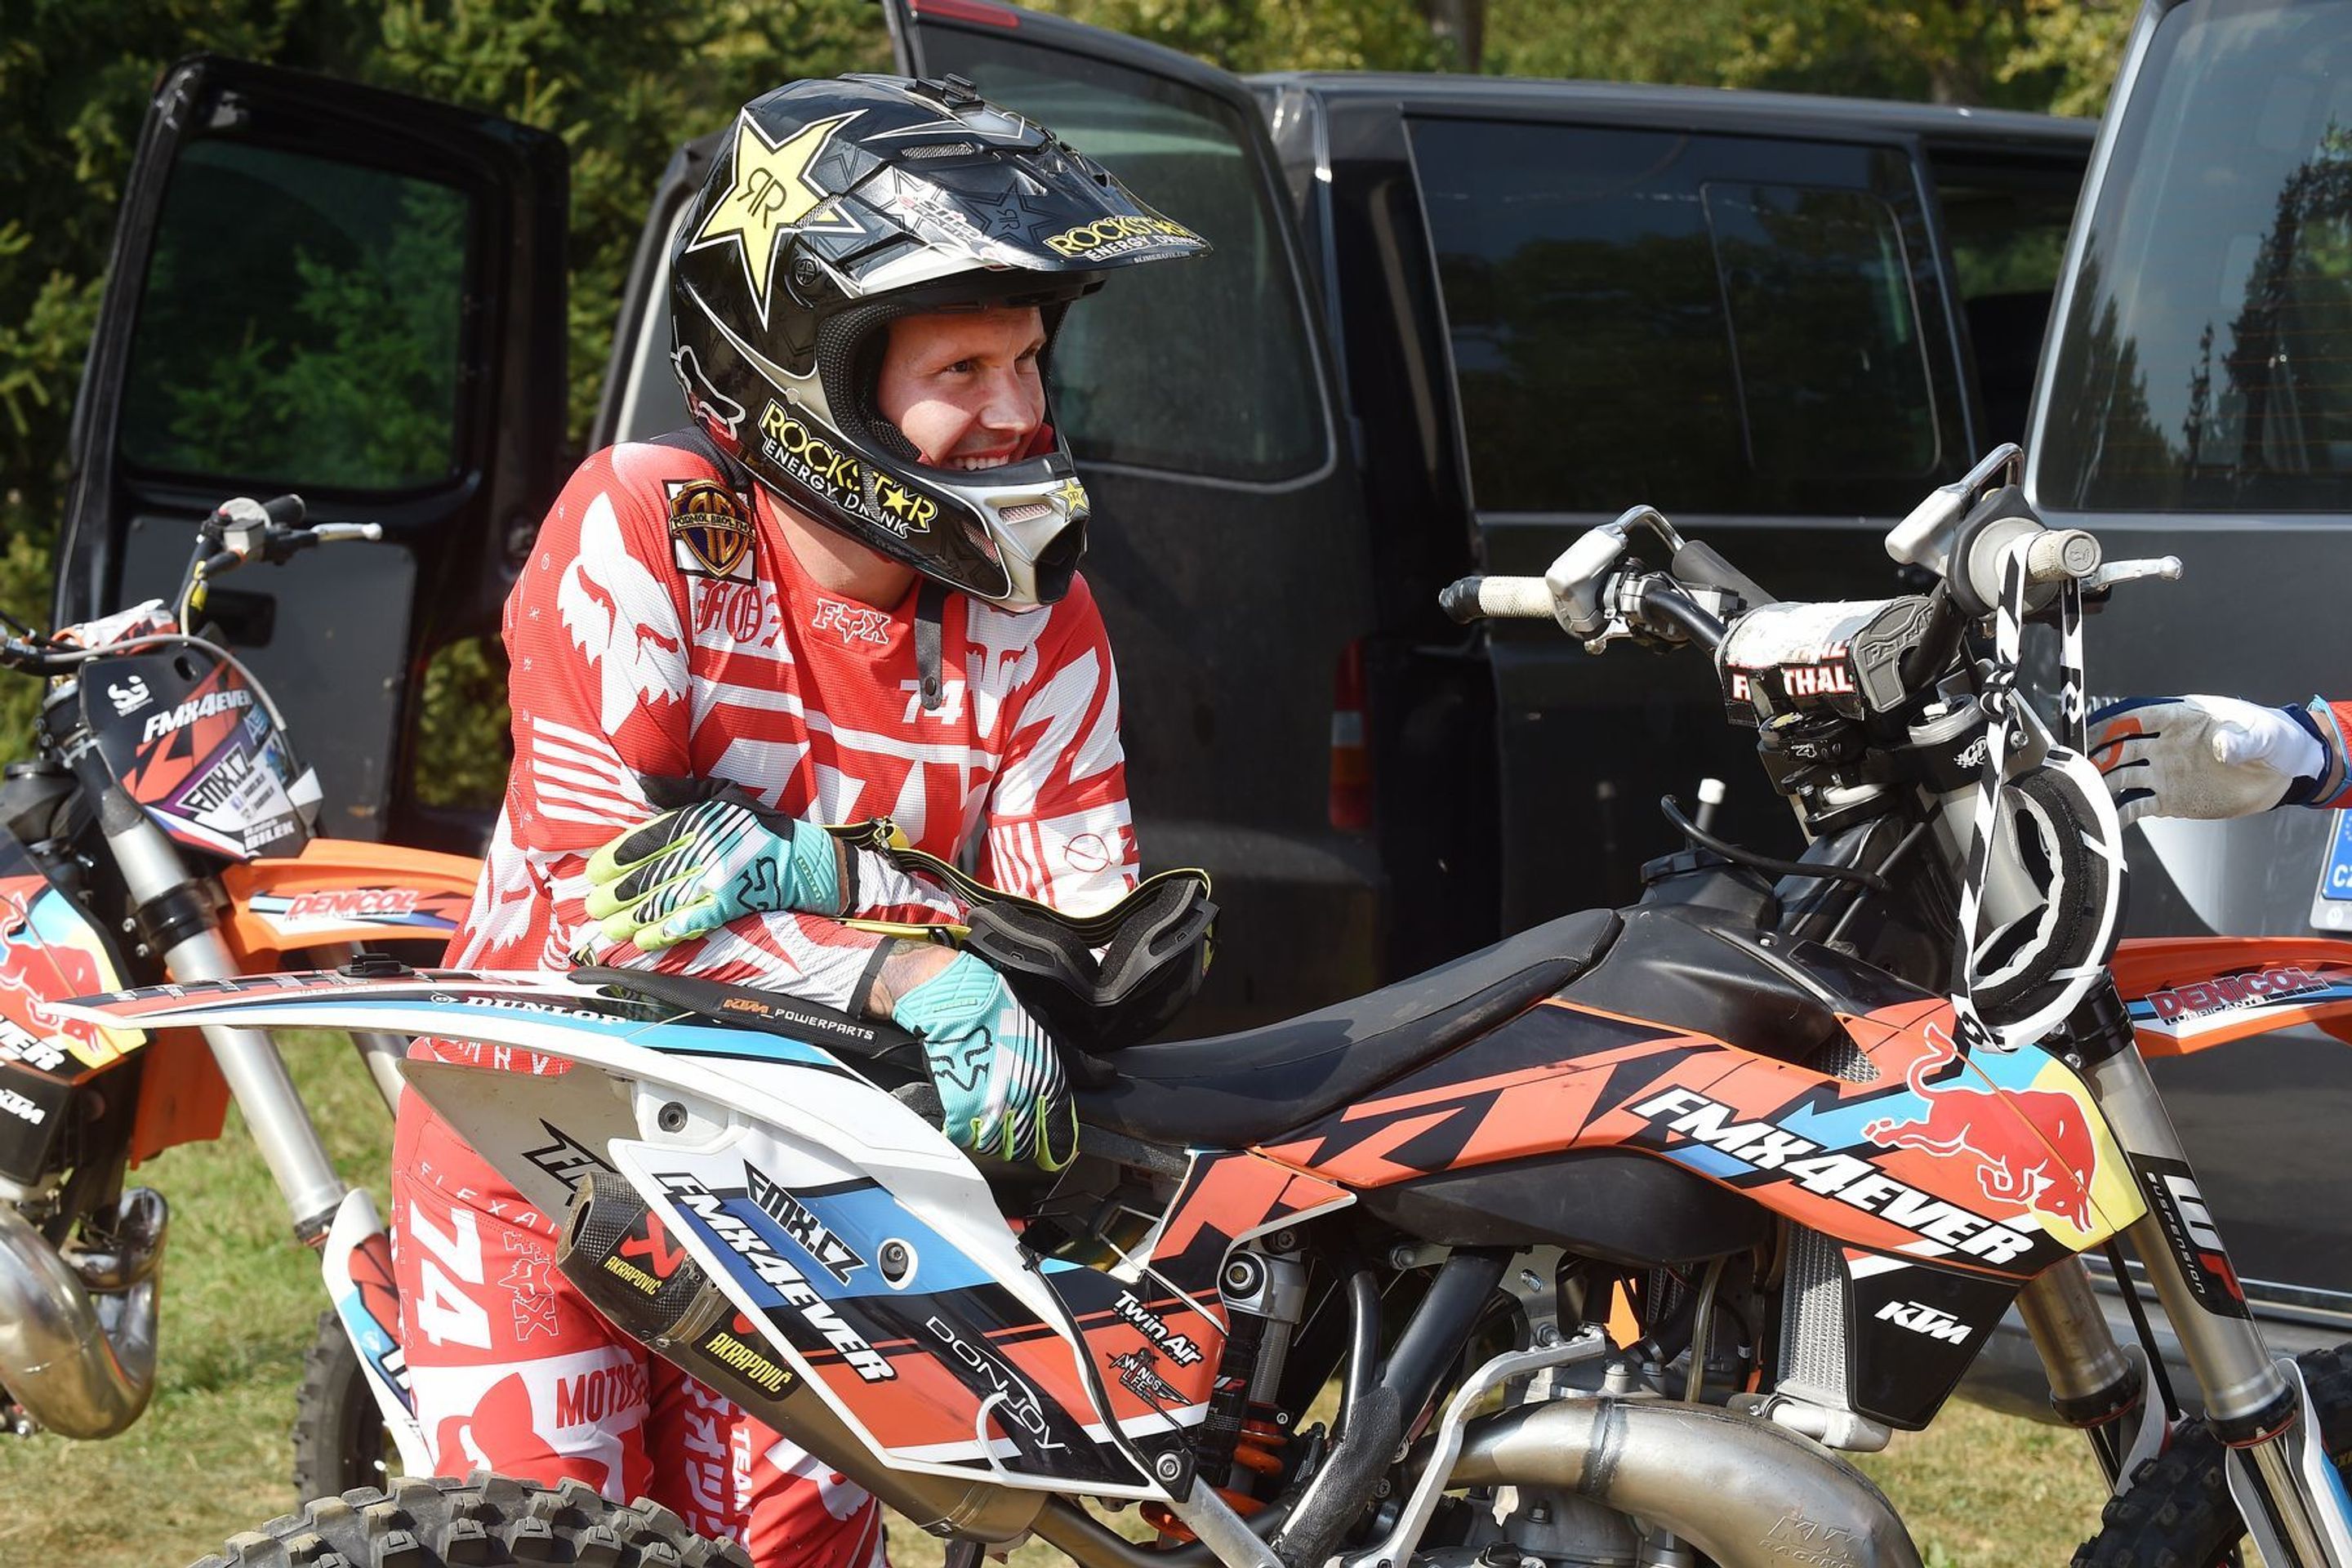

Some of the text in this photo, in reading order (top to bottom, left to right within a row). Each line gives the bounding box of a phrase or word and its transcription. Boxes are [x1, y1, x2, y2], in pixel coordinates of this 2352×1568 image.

[1086, 235, 1204, 260] ENERGY DRINK
[765, 439, 908, 535] ENERGY DRNK
[900, 679, 966, 725] 74
[1733, 665, 1856, 701] RTHAL
[462, 996, 628, 1025] DUNLOP
[1633, 1087, 2035, 1266] FMX4EVER
[744, 1159, 867, 1287] FMX.CZ
[410, 1198, 493, 1350] 74
[655, 1174, 898, 1381] FMX4EVER
[1114, 1290, 1202, 1365] Twin Air
[1874, 1300, 1973, 1345] KTM
[926, 1316, 1065, 1451] DONJOY
